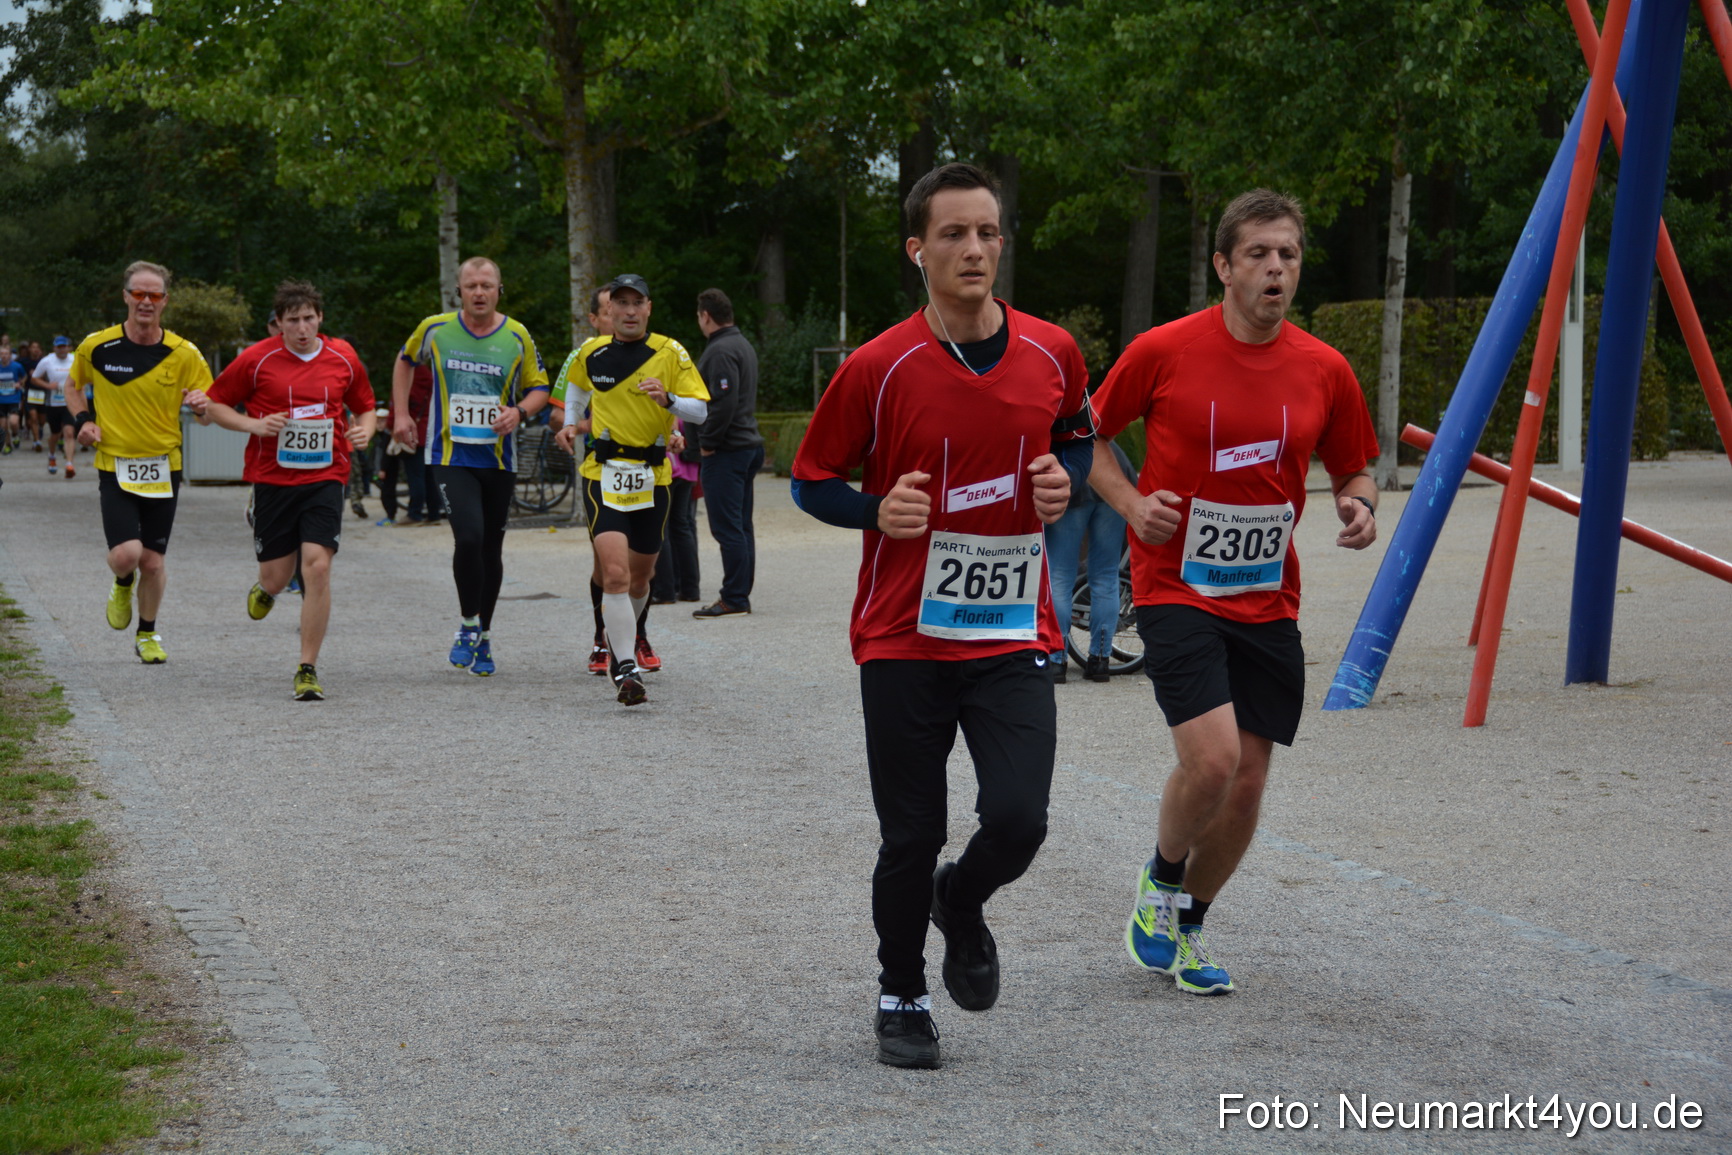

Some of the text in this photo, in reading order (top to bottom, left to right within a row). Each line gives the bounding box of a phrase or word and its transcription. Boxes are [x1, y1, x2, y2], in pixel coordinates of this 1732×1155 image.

[104, 364, 133, 372] Markus
[446, 358, 504, 376] BOCK
[592, 375, 615, 383] Steffen
[455, 406, 497, 425] 3116
[284, 431, 328, 450] 2581
[286, 453, 324, 462] Carl-Jonas
[1233, 449, 1261, 463] DEHN
[128, 464, 159, 481] 525
[613, 472, 644, 491] 345
[616, 495, 640, 504] Steffen
[966, 486, 997, 502] DEHN
[1192, 508, 1280, 524] PARTL Neumarkt
[933, 541, 1026, 557] PARTL Neumarkt
[1196, 525, 1283, 561] 2303
[936, 558, 1029, 600] 2651
[1207, 568, 1262, 584] Manfred
[953, 609, 1004, 625] Florian
